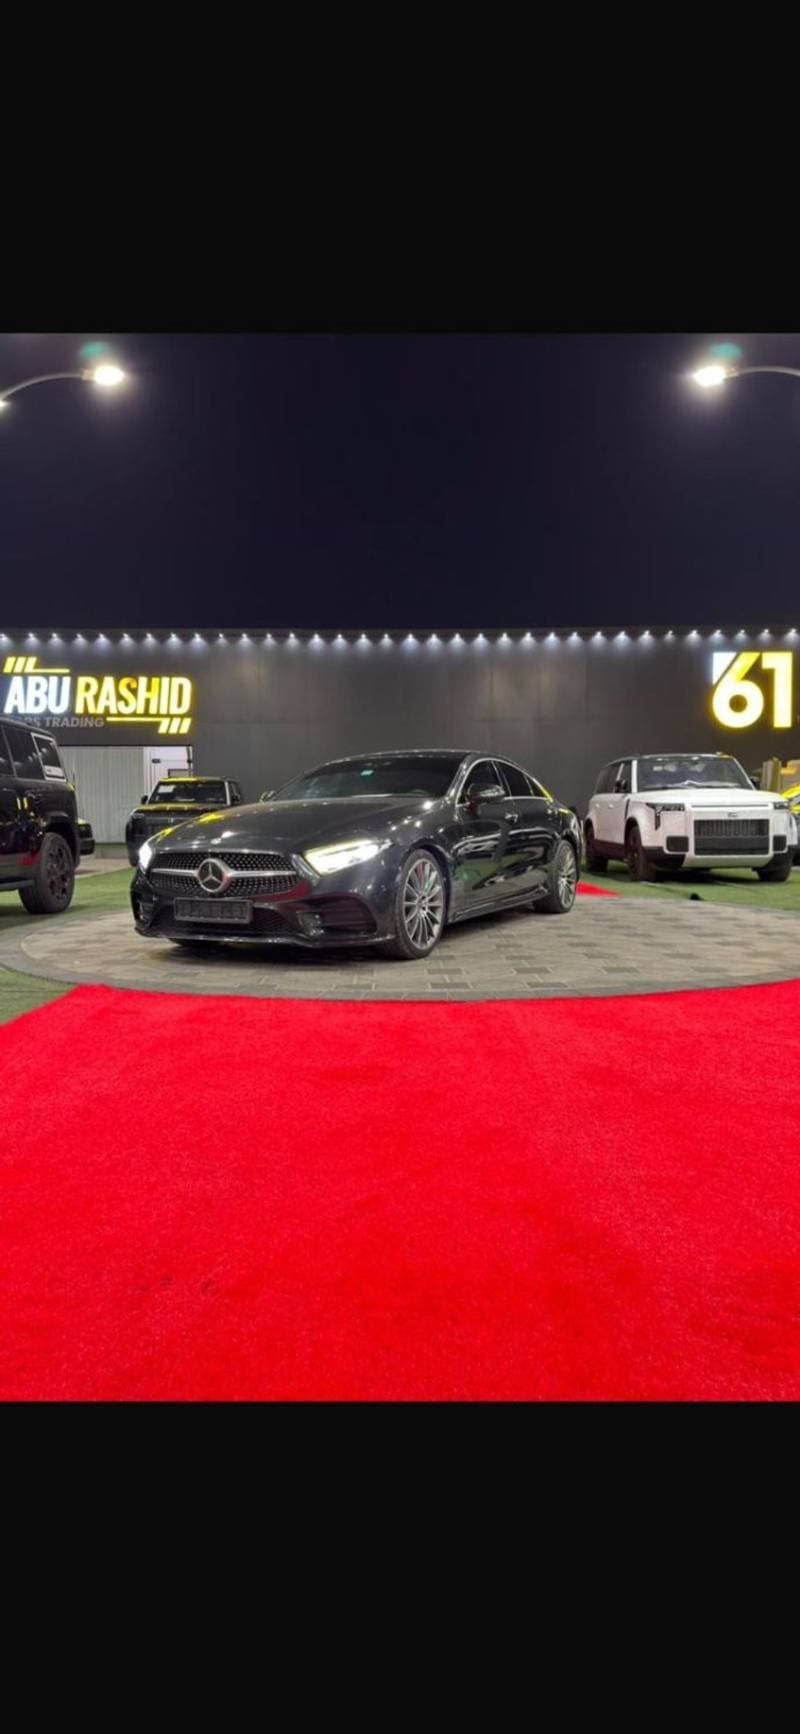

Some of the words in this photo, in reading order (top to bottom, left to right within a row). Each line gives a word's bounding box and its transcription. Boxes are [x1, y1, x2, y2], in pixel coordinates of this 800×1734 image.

[4, 675, 71, 714] ABU
[75, 675, 192, 714] RASHID
[712, 652, 792, 728] 61
[44, 716, 105, 727] TRADING
